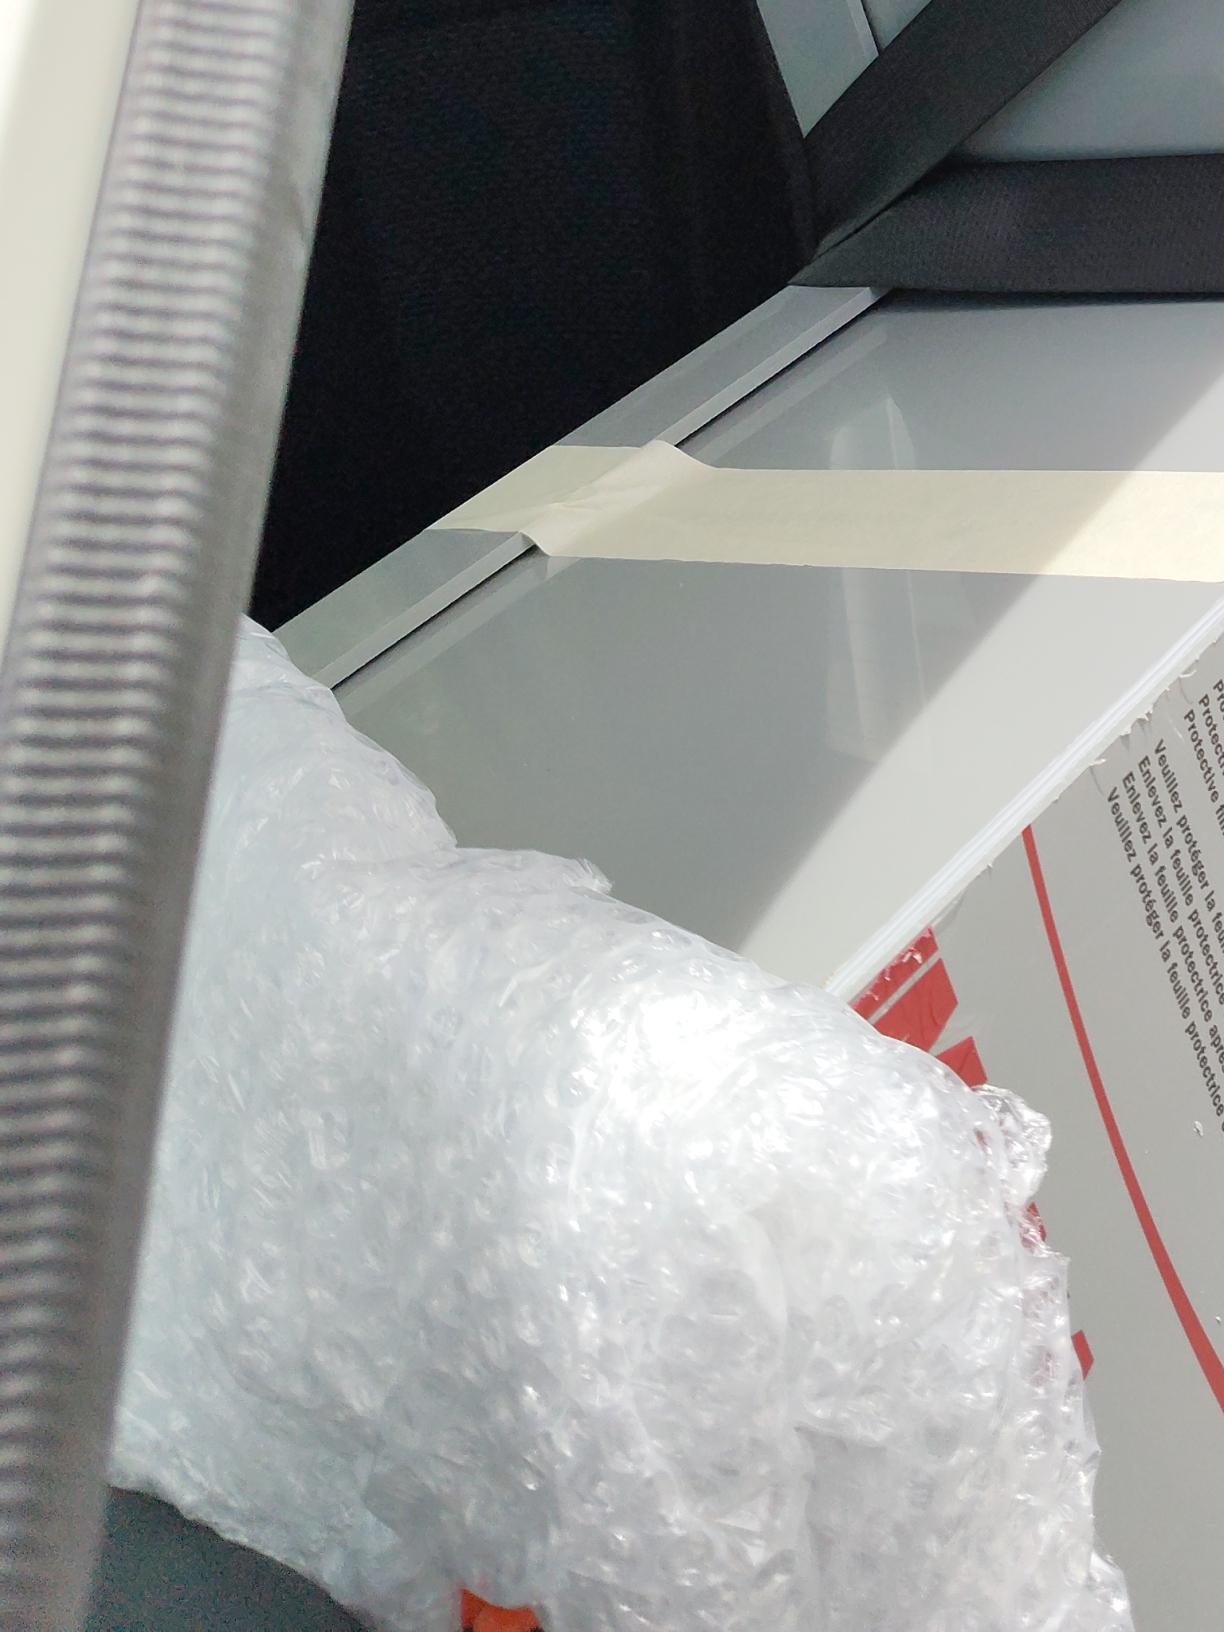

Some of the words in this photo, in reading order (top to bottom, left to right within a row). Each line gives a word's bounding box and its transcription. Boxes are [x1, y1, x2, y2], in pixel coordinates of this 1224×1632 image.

[1136, 753, 1168, 829] Enlevez
[1161, 825, 1174, 850] la
[1168, 847, 1194, 907] feuille
[1153, 737, 1183, 814] Veuillez
[1174, 813, 1210, 890] protéger
[1202, 888, 1216, 913] la
[1182, 707, 1220, 804] Protective
[1105, 785, 1138, 863] Veuillez
[1128, 862, 1165, 940] protéger
[1157, 938, 1172, 963] la
[1165, 960, 1191, 1020] feuille
[1183, 1019, 1224, 1118] protectrice
[1120, 769, 1152, 845] Enlevez
[1145, 841, 1160, 867] la
[1153, 864, 1179, 924] feuille
[1171, 923, 1213, 1023] protectrice
